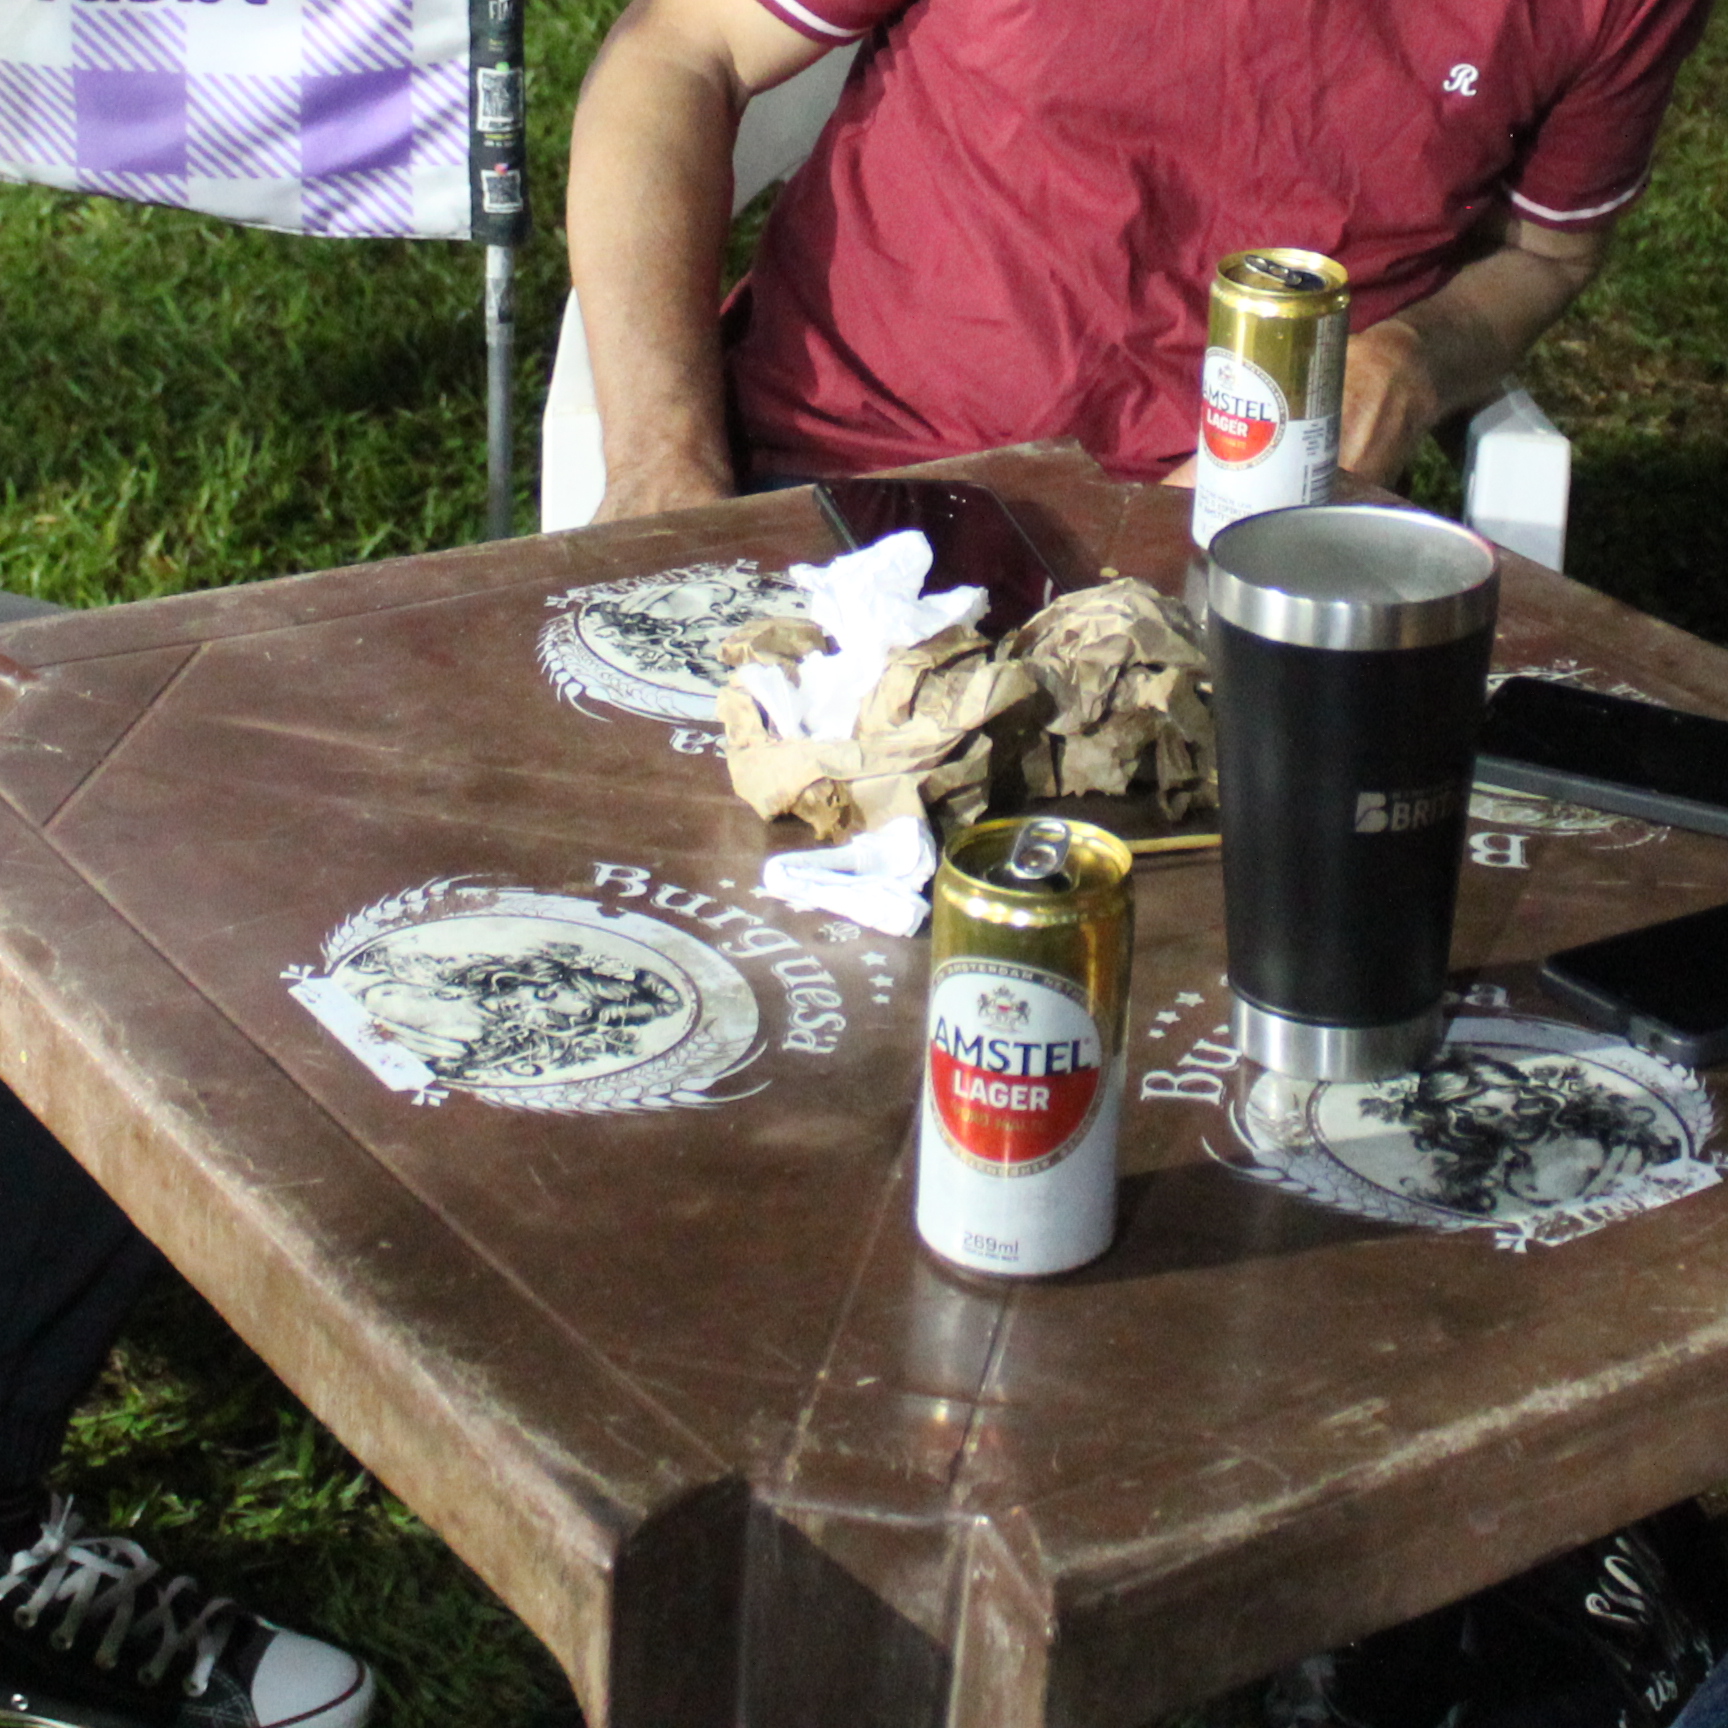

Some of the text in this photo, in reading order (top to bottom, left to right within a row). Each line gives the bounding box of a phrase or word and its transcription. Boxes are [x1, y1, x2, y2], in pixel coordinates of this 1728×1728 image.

[1207, 407, 1249, 438] LAGER
[934, 1015, 1093, 1077] AMSTEL
[953, 1069, 1050, 1112] LAGER
